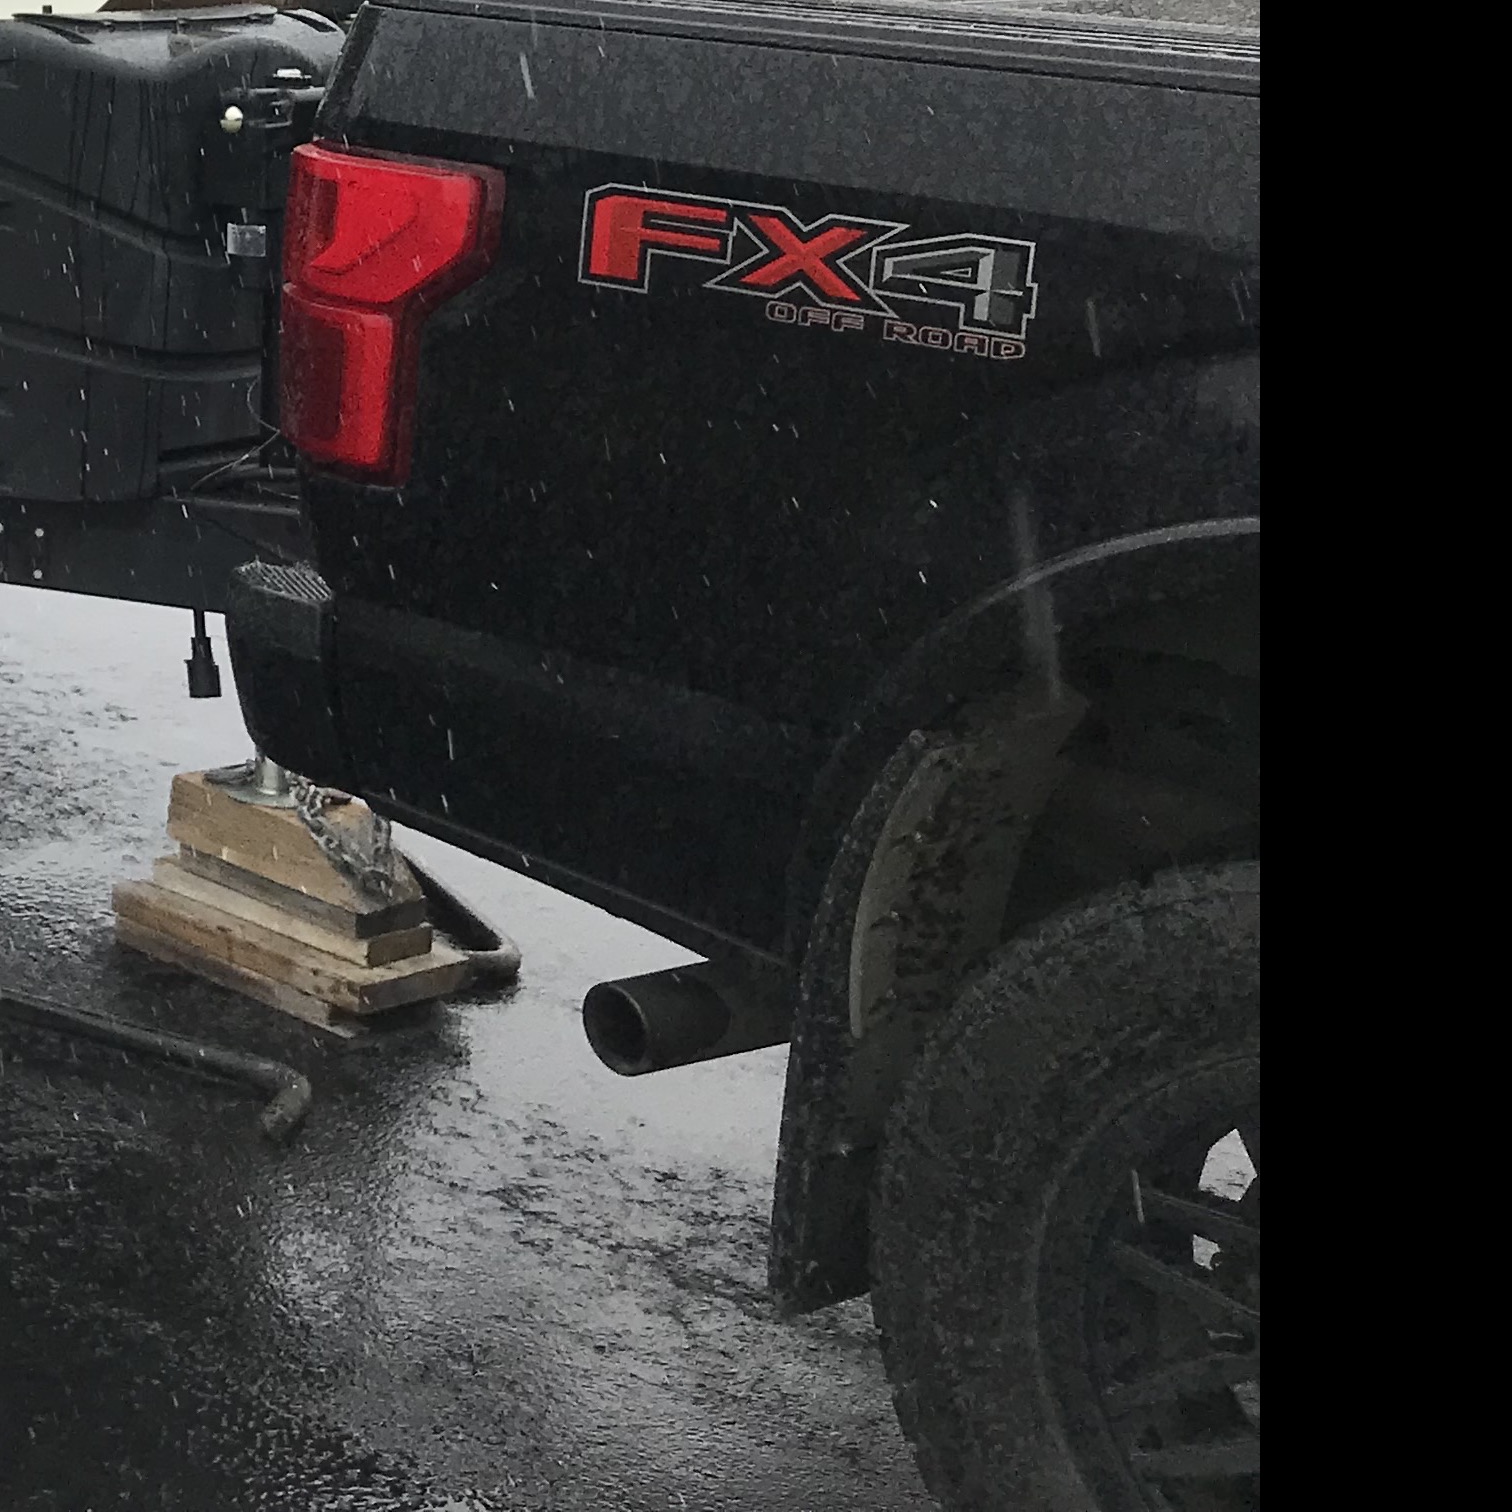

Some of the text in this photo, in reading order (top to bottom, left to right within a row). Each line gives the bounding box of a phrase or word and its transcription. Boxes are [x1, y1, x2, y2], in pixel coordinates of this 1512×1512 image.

[578, 182, 1038, 339] FX4
[765, 300, 1026, 360] OFF ROAD
